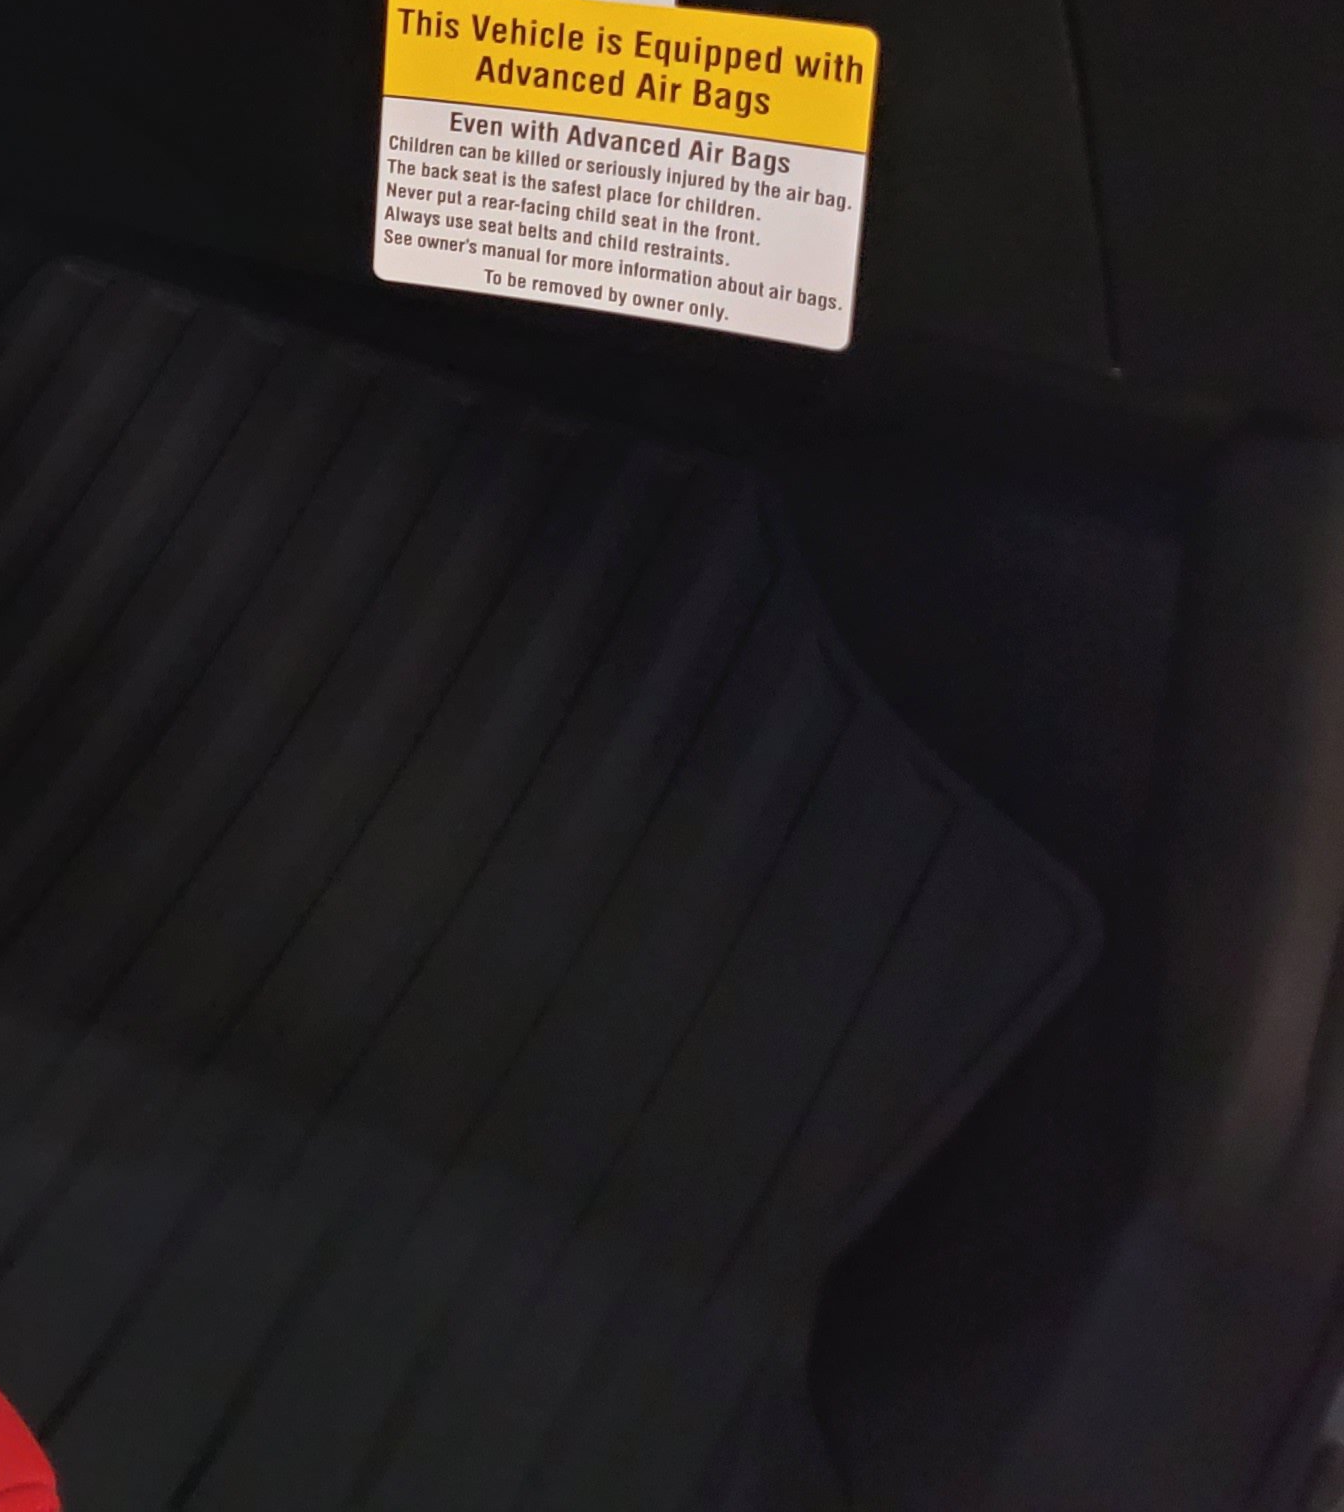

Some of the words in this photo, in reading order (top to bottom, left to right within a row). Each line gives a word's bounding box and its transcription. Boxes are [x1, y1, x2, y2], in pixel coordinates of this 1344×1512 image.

[398, 8, 459, 39] This
[472, 14, 583, 52] Vehicle
[597, 26, 622, 55] is
[634, 30, 782, 74] Equipped
[795, 52, 863, 85] with
[475, 55, 624, 99] Advanced
[636, 73, 682, 103] Air
[693, 79, 770, 119] Bags
[389, 135, 454, 156] Children
[459, 145, 486, 160] can
[492, 146, 511, 162] be
[516, 149, 560, 169] killed
[565, 157, 582, 171] or
[586, 159, 661, 184] seriously
[666, 167, 725, 190] injured
[730, 176, 749, 197] by
[755, 180, 781, 198] the
[786, 187, 810, 203] air
[815, 189, 852, 212] bag.
[450, 112, 502, 136] Even
[512, 120, 558, 143] with
[566, 125, 680, 158] Advanced
[689, 140, 723, 164] Air
[732, 145, 790, 175] Bags
[386, 182, 433, 201] Never
[437, 190, 462, 206] put
[467, 194, 476, 206] a
[482, 196, 570, 221] rear-facing
[576, 206, 615, 225] child
[621, 213, 656, 231] seat
[662, 217, 678, 234] in
[683, 221, 709, 238] the
[715, 224, 760, 246] front.
[387, 159, 416, 175] The
[421, 163, 458, 180] back
[463, 169, 497, 185] seat
[502, 172, 516, 187] is
[521, 174, 546, 190] the
[552, 179, 601, 199] safest
[606, 186, 651, 205] place
[657, 191, 680, 209] for
[685, 196, 761, 221] children.
[384, 206, 440, 228] Always
[446, 216, 473, 230] use
[479, 219, 512, 235] seat
[518, 222, 557, 240] belts
[562, 229, 592, 246] and
[598, 234, 638, 252] child
[644, 240, 730, 266] restraints.
[383, 229, 412, 246] See
[417, 235, 477, 254] owner's
[482, 243, 540, 262] manual
[546, 249, 567, 266] for
[572, 255, 613, 273] more
[618, 259, 712, 288] information
[717, 276, 764, 298] about
[769, 285, 792, 302] air
[797, 288, 842, 311] bags.
[484, 269, 502, 285] To
[507, 272, 526, 289] be
[532, 278, 603, 300] removed
[608, 286, 627, 307] by
[632, 293, 684, 313] owner
[689, 302, 729, 323] only.
